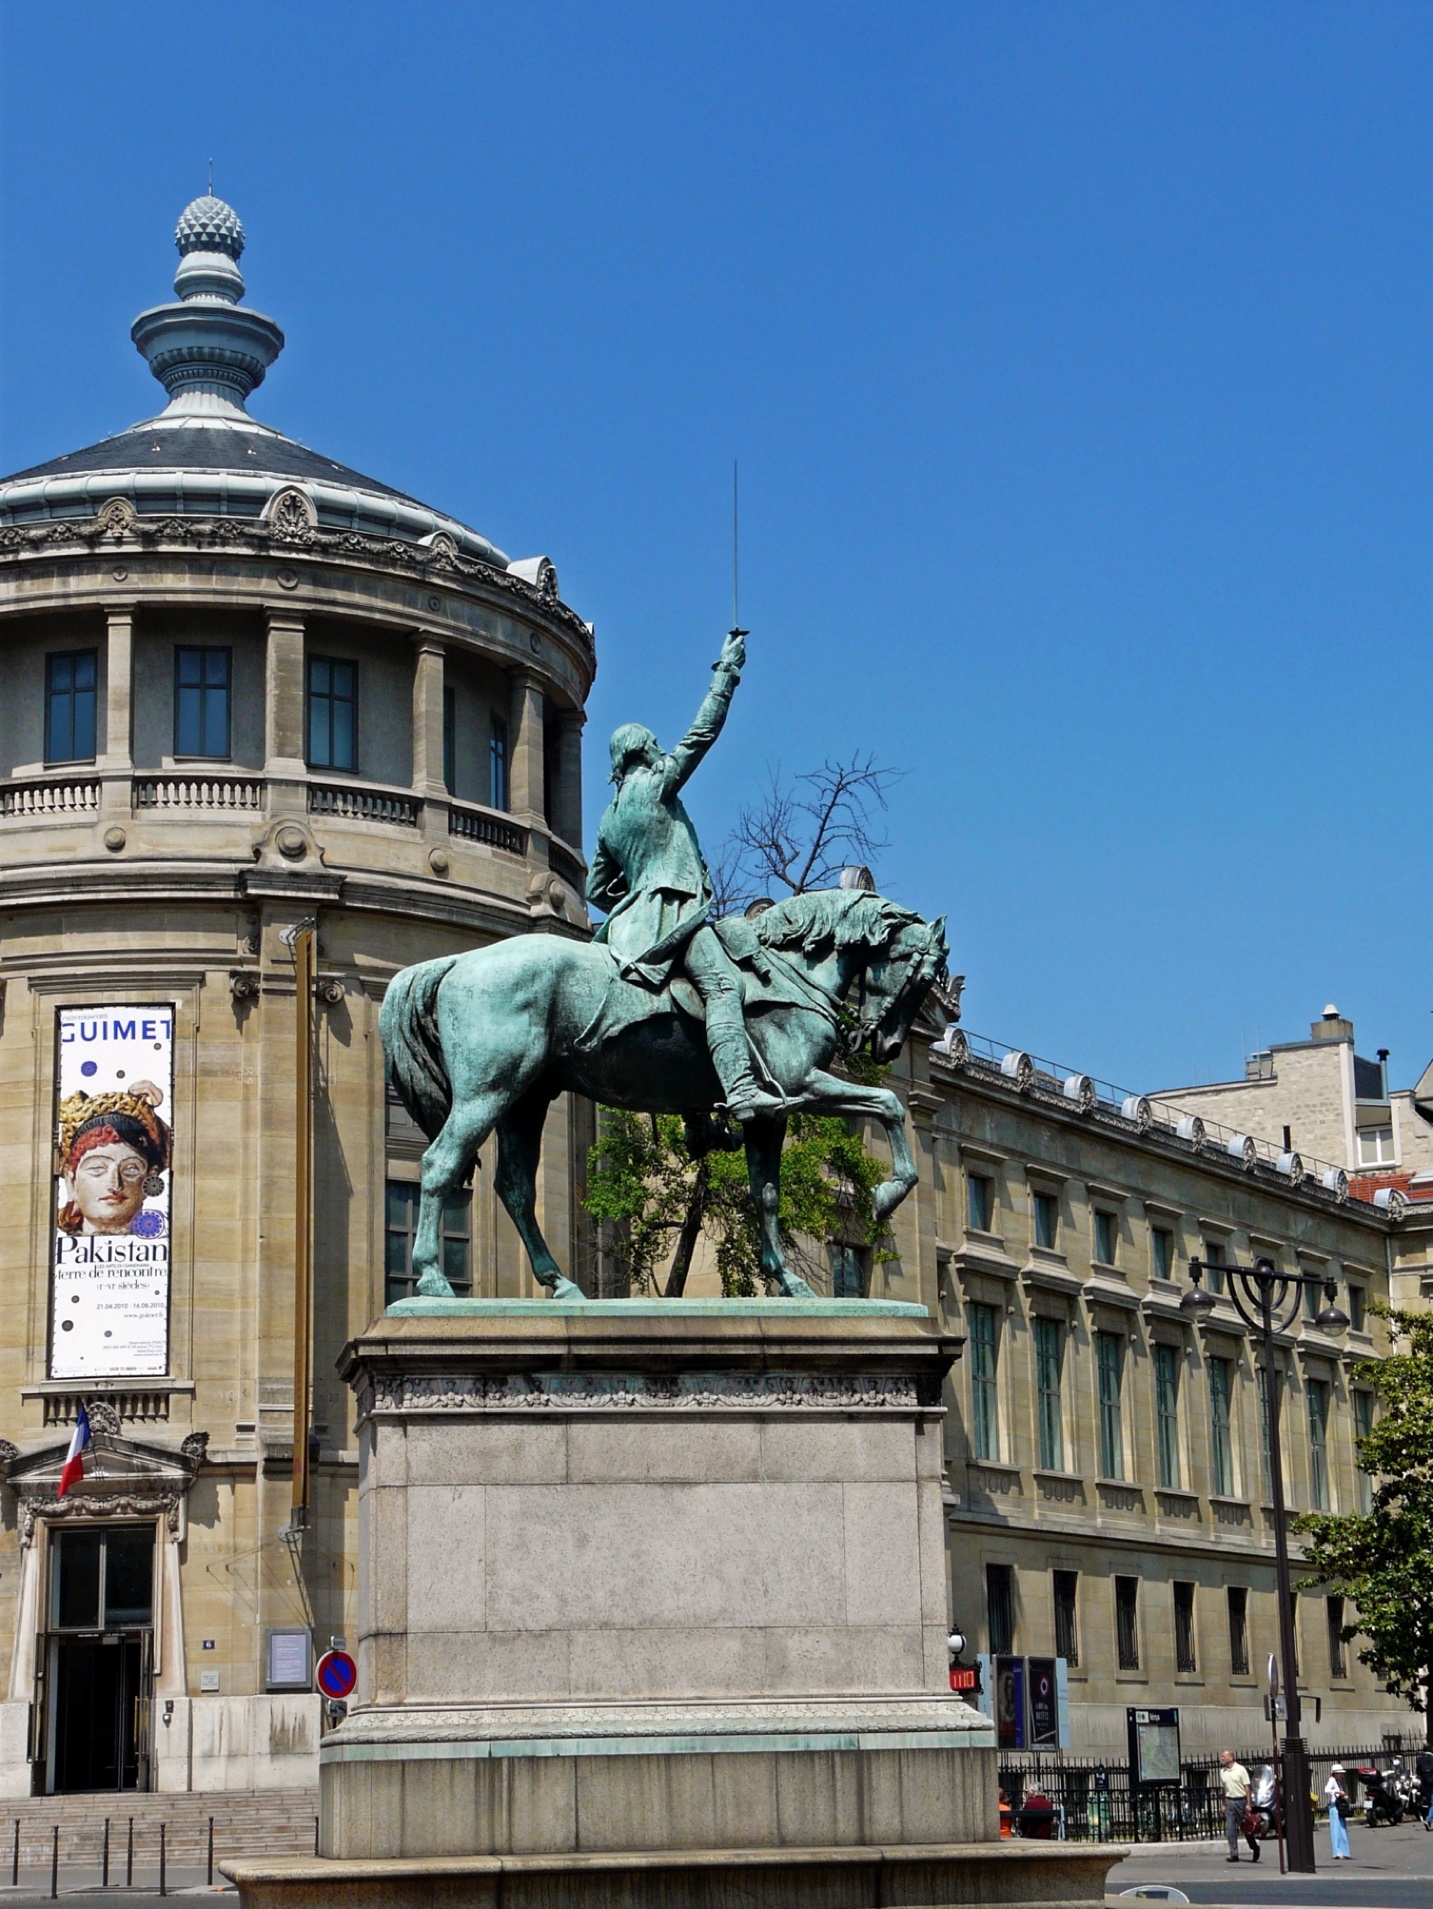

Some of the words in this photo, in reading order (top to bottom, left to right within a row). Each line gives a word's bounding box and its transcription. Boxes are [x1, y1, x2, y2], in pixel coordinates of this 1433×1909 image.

[62, 1020, 171, 1043] GUIMET
[57, 1235, 168, 1265] Pakistan
[59, 1269, 87, 1280] terre
[89, 1265, 104, 1279] de
[107, 1266, 168, 1278] rencontre
